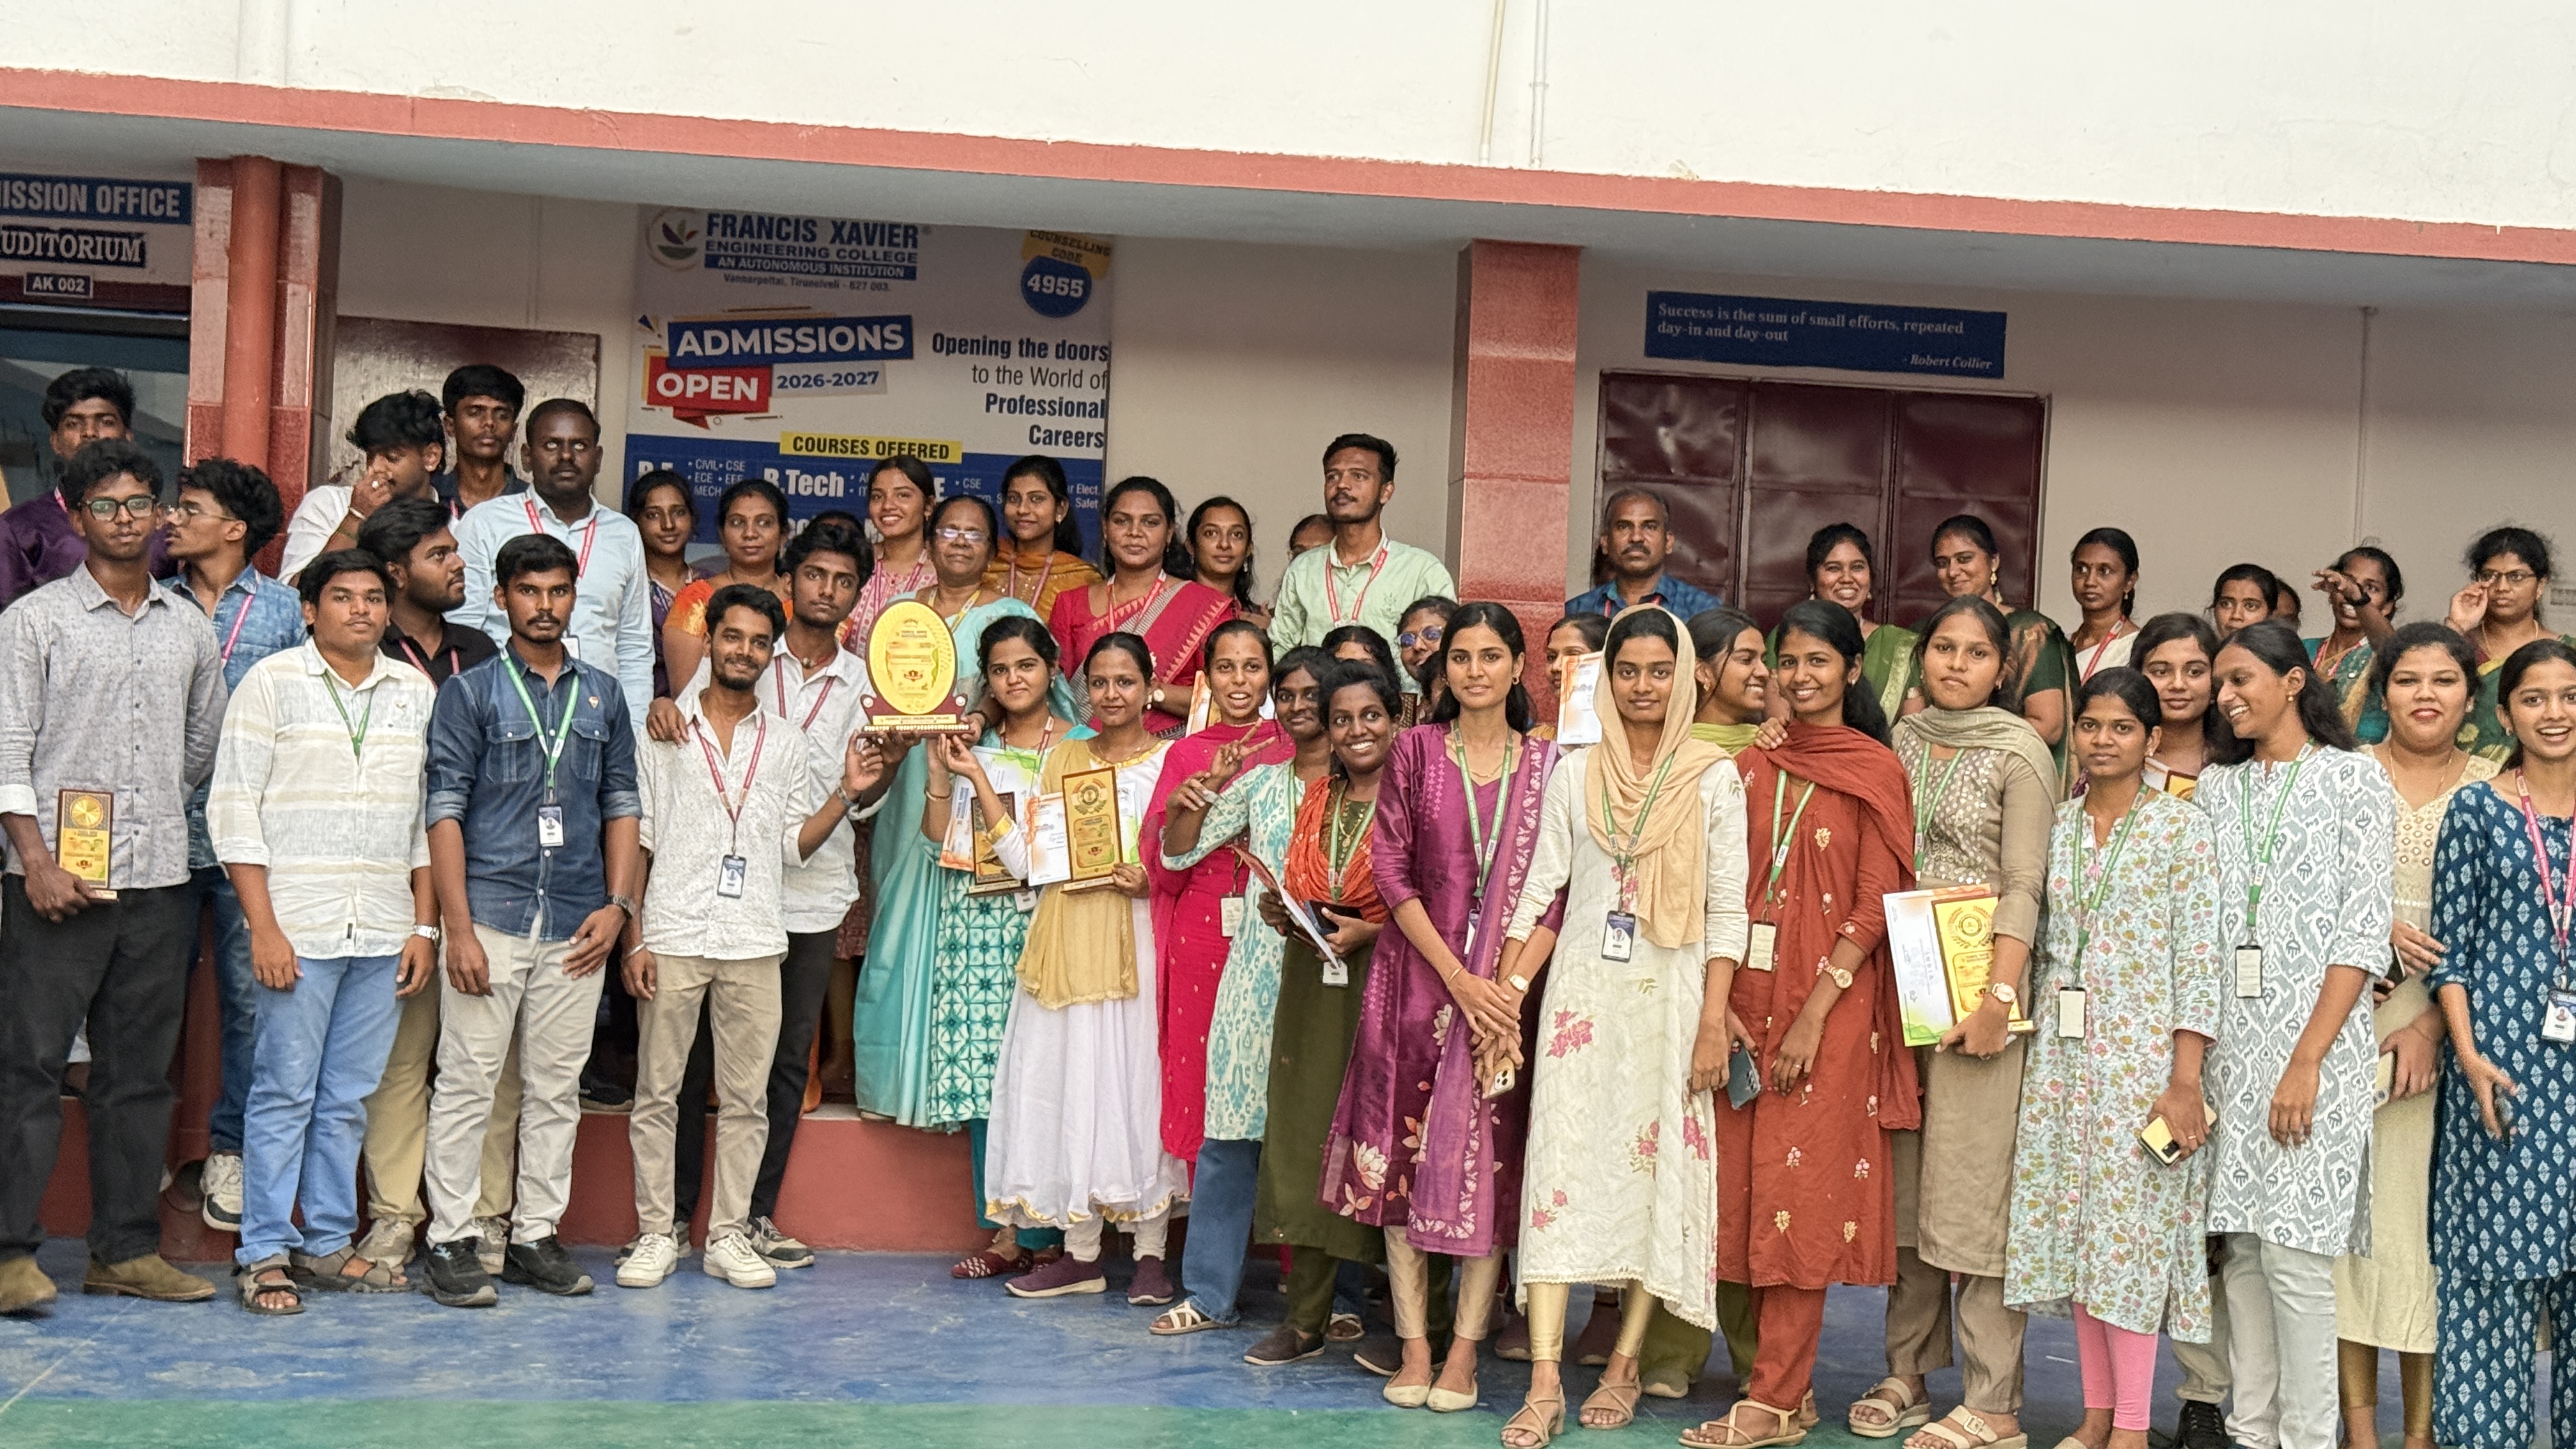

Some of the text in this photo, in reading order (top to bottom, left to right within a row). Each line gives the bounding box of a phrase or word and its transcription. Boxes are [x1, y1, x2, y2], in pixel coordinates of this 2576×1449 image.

[0, 181, 180, 218] ISSION OFFICE
[707, 213, 919, 249] FRANCIS XAVIER
[0, 230, 141, 263] UDITORIUM
[705, 240, 918, 264] ENGINEERING COLLEGE
[718, 256, 905, 277] AN AUTONOMOUS INSTITUTION
[33, 276, 85, 293] AK 002
[1027, 273, 1084, 298] 4955
[1659, 303, 1713, 318] Success
[1718, 307, 1729, 319] is
[1733, 308, 1755, 321] the
[1758, 313, 1787, 323] sum
[1791, 312, 1807, 325] of
[1809, 314, 1845, 327] small
[1904, 321, 1965, 334] repeated
[676, 324, 905, 356] ADMISSIONS
[1658, 321, 1789, 342] day-in and day-out
[932, 333, 1109, 362] Opening the doors
[1910, 355, 1949, 366] Robert
[1952, 356, 1993, 369] Collier
[656, 373, 759, 401] OPEN
[777, 371, 879, 390] 2026-2027
[971, 365, 1108, 390] to the World of
[986, 393, 1106, 418] Professional
[793, 436, 949, 459] COURSES OFFERED
[1029, 425, 1104, 448] Careers
[695, 459, 746, 471] CIVIL CSE
[694, 472, 713, 483] ECE
[764, 467, 845, 497] B.Tech
[963, 478, 982, 489] CSE
[694, 486, 722, 496] MECH
